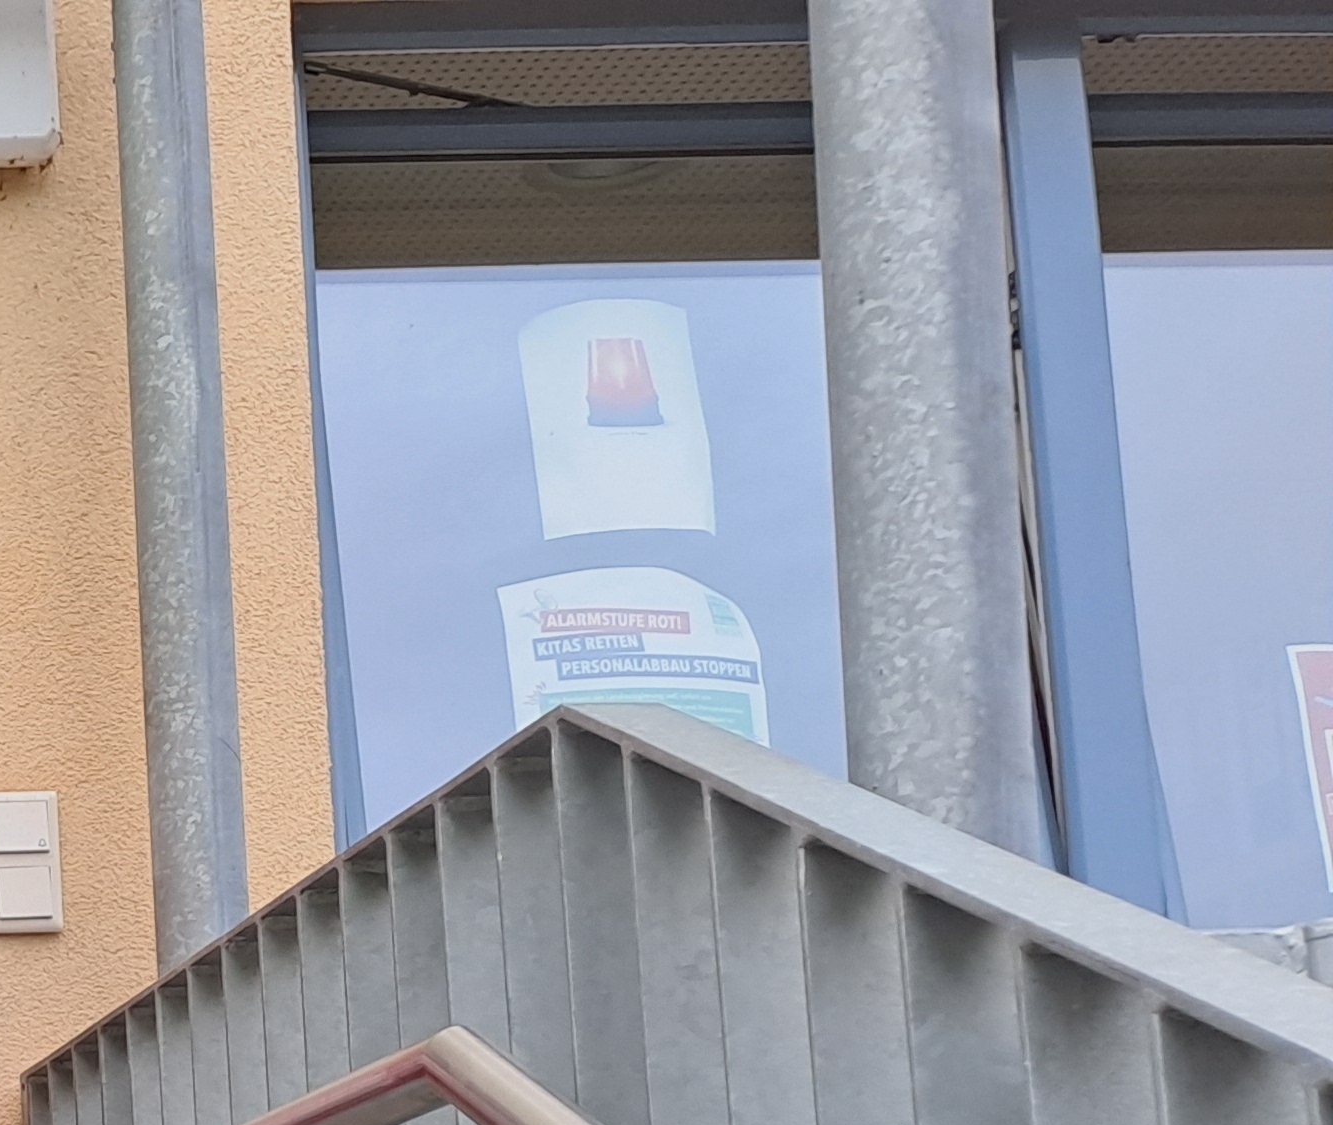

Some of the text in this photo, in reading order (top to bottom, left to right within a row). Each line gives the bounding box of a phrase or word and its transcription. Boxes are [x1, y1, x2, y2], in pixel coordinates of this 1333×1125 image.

[546, 611, 681, 630] ALARMSTUFE ROT!
[536, 634, 639, 656] KITAS RETTEN
[561, 659, 751, 678] PERSONALABBAU STOPPEN
